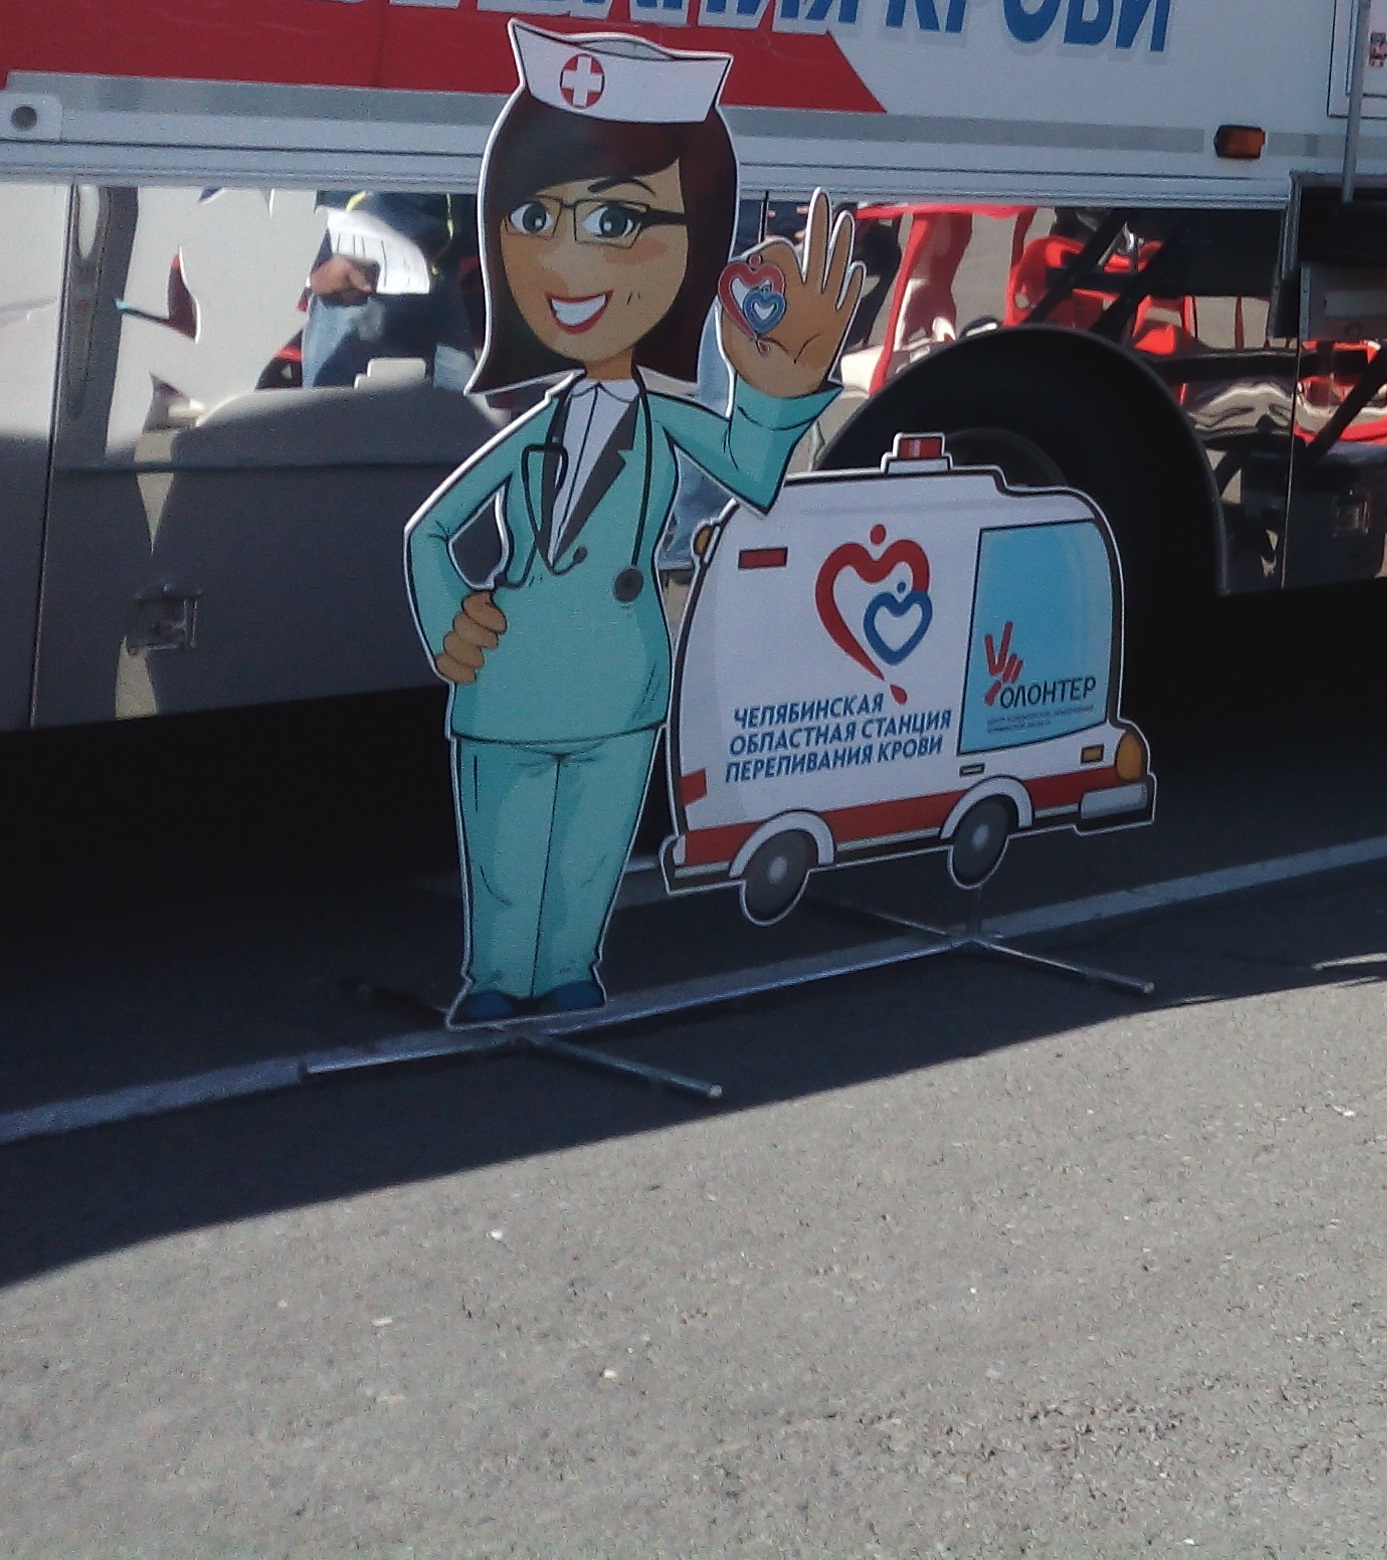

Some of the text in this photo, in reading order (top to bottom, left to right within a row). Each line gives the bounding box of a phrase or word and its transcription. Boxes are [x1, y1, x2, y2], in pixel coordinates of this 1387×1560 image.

[729, 721, 857, 756] ОБЛАСТНАЯ
[861, 709, 952, 740] СТАНЦИЯ
[733, 692, 885, 730] ЧЕЛЯБИНСКАЯ
[724, 735, 943, 784] ПЕРЕЛИВАНИЯ КРОВИ
